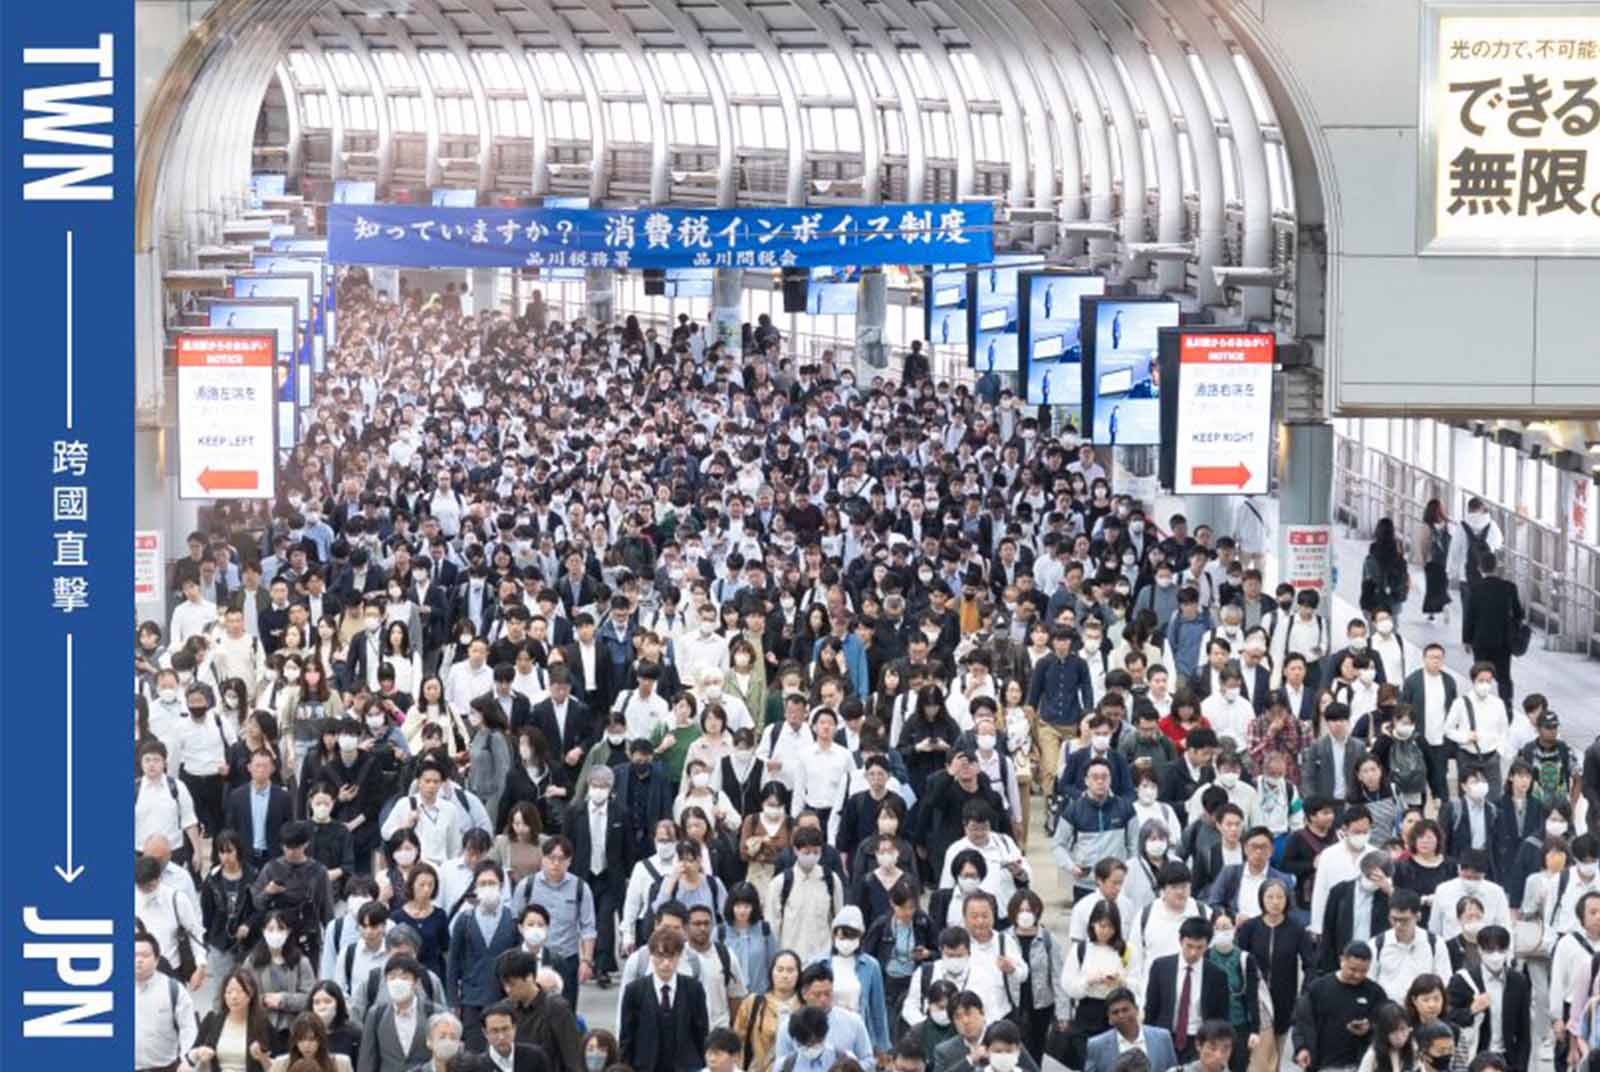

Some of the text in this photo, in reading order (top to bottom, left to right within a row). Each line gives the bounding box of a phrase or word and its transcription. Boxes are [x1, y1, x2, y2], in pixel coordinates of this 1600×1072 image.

[1448, 73, 1600, 138] できる
[353, 208, 970, 250] 知っていますか？ 消費税インボイス制度
[525, 250, 632, 268] 品川税務署
[198, 435, 255, 447] KEEP LEFT
[1192, 431, 1254, 443] KEEP RIGHT
